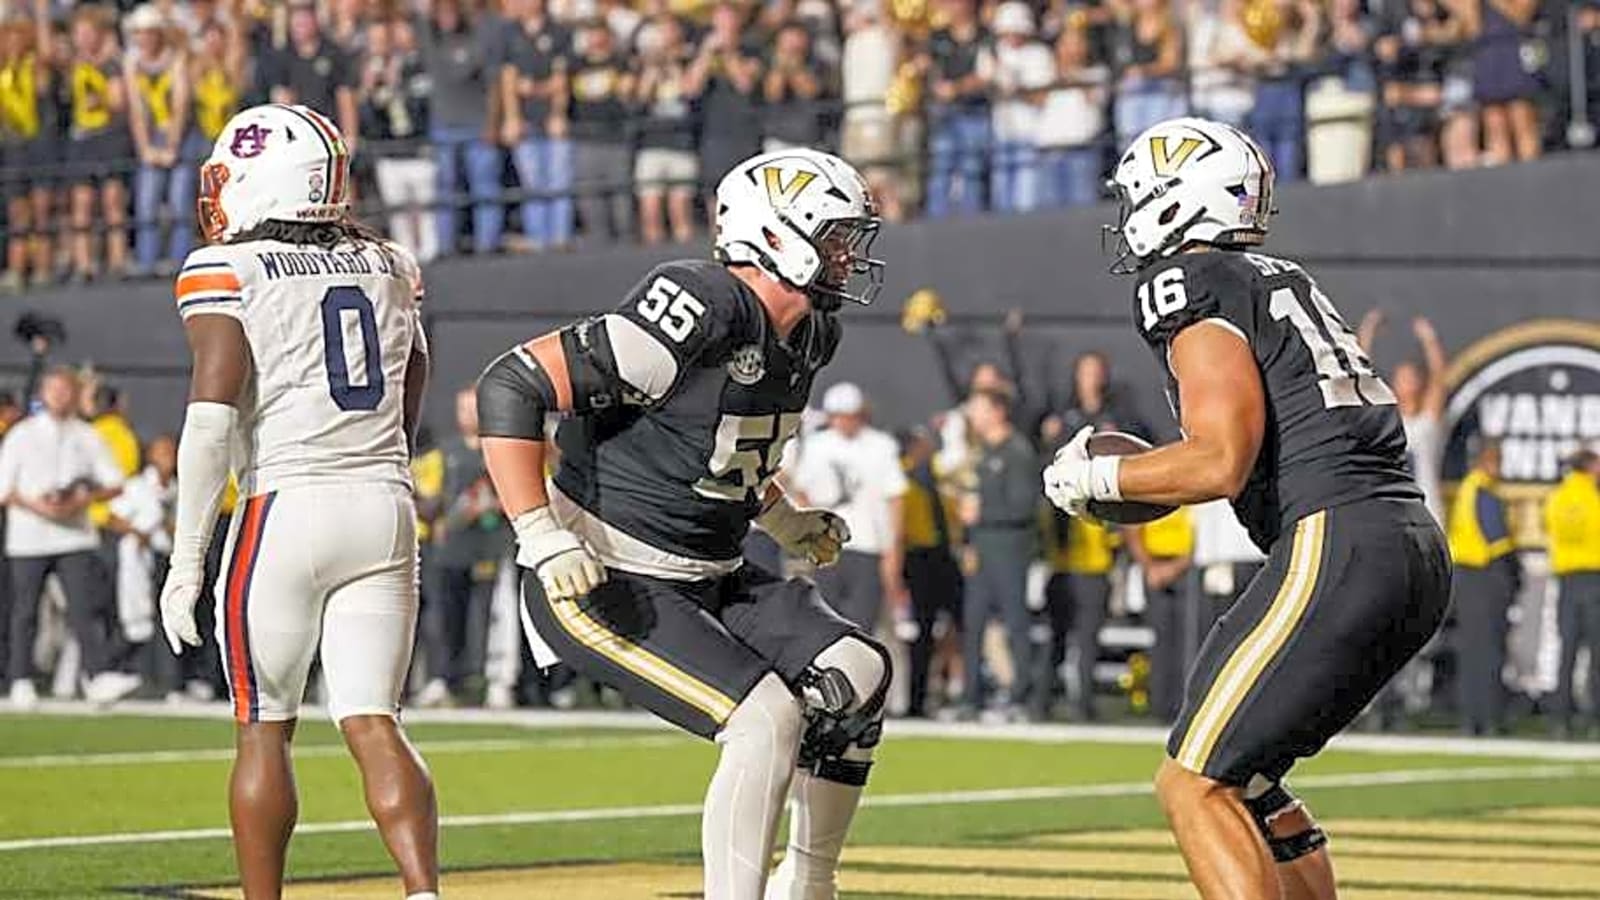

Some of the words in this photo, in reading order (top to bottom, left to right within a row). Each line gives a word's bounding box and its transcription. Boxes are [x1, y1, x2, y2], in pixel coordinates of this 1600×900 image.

[1149, 136, 1205, 177] V
[763, 166, 818, 209] V
[257, 251, 371, 281] WOODYARD
[637, 275, 707, 343] 55
[1137, 266, 1188, 332] 16
[321, 285, 385, 412] 0
